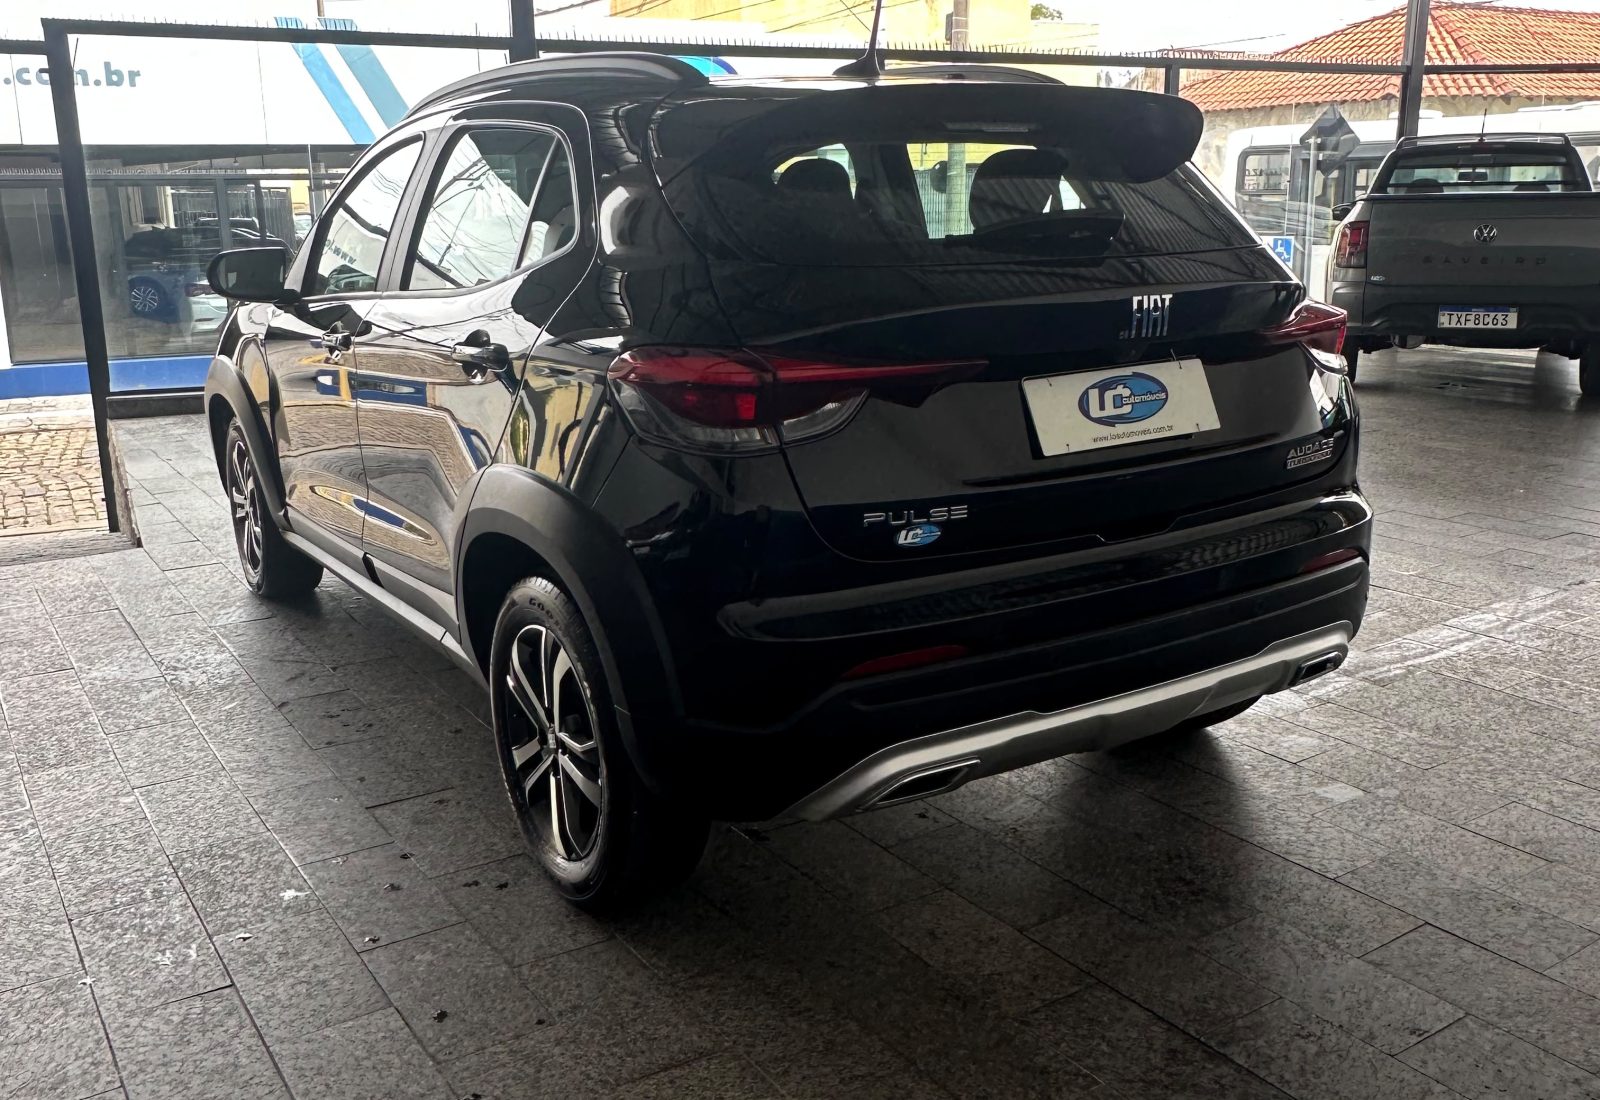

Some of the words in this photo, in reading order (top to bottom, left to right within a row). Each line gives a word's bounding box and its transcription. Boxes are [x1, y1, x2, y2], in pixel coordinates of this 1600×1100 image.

[1130, 294, 1174, 339] FIAT
[1446, 313, 1509, 327] TXF8C63
[1286, 437, 1335, 459] AUDACE
[863, 504, 968, 527] PULSE
